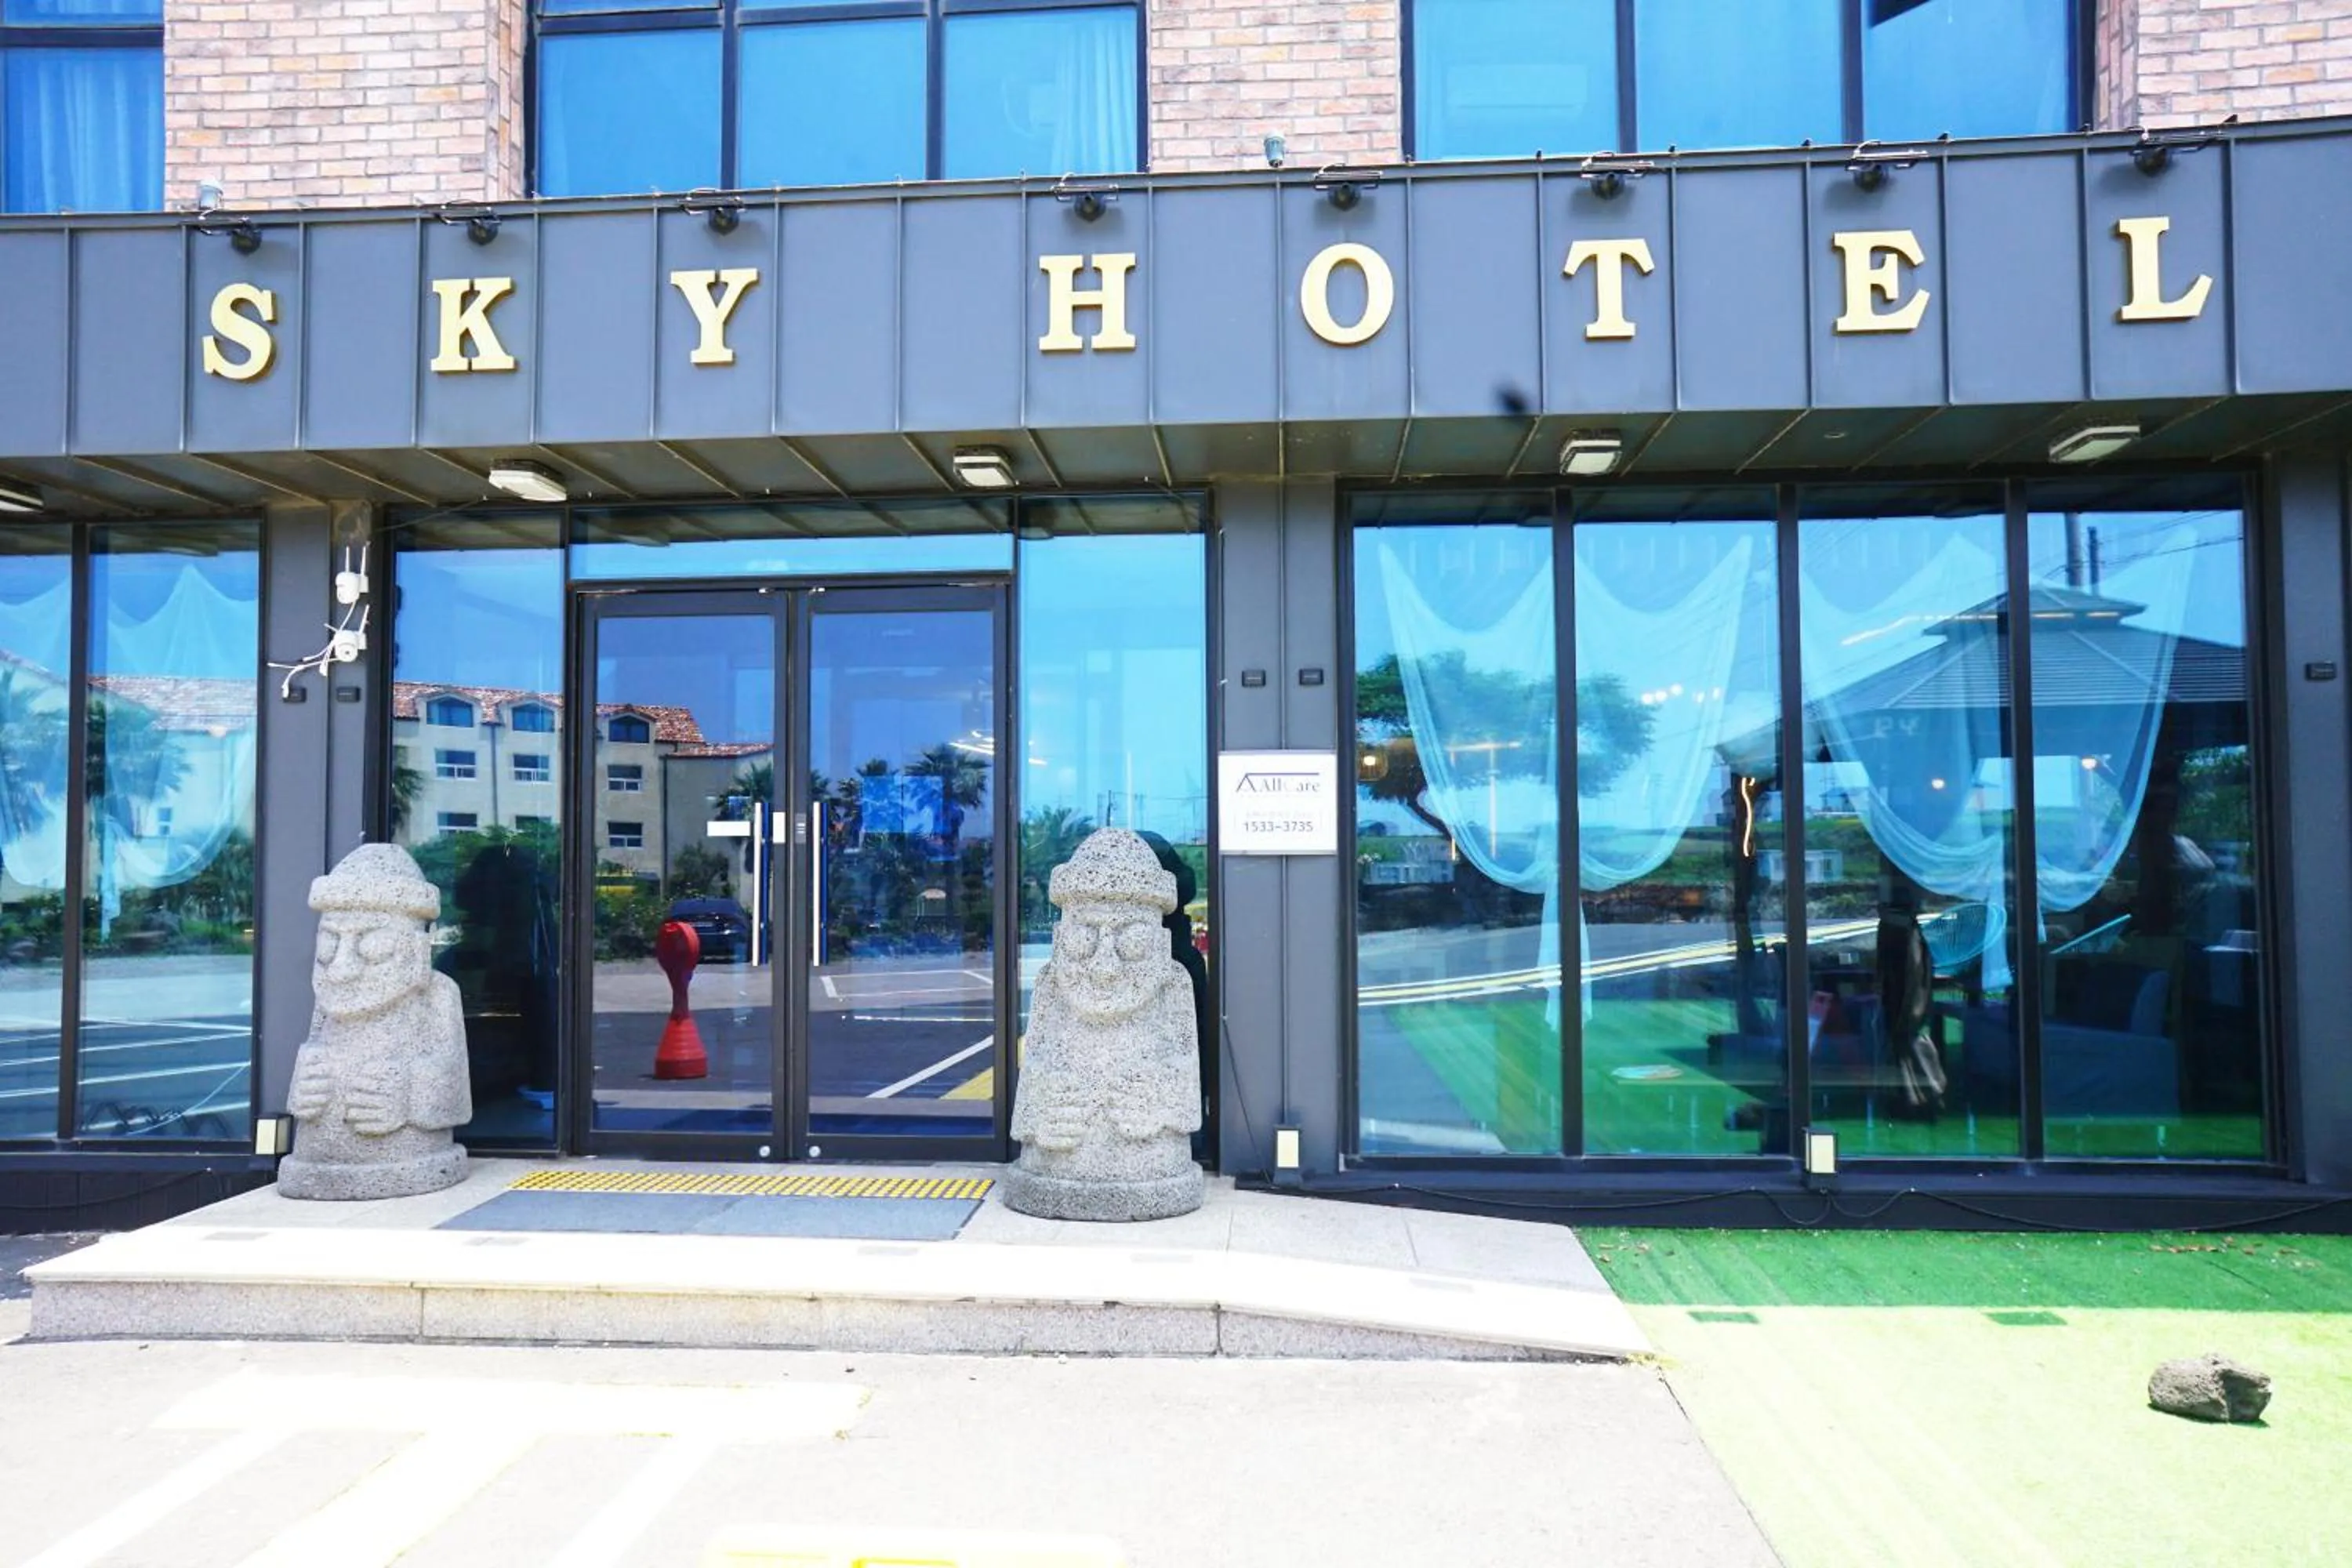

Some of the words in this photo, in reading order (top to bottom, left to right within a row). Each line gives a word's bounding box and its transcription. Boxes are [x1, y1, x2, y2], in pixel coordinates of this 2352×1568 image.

[202, 268, 760, 380] SKY
[1038, 216, 2213, 351] HOTEL
[1243, 821, 1314, 832] 1533-3735
